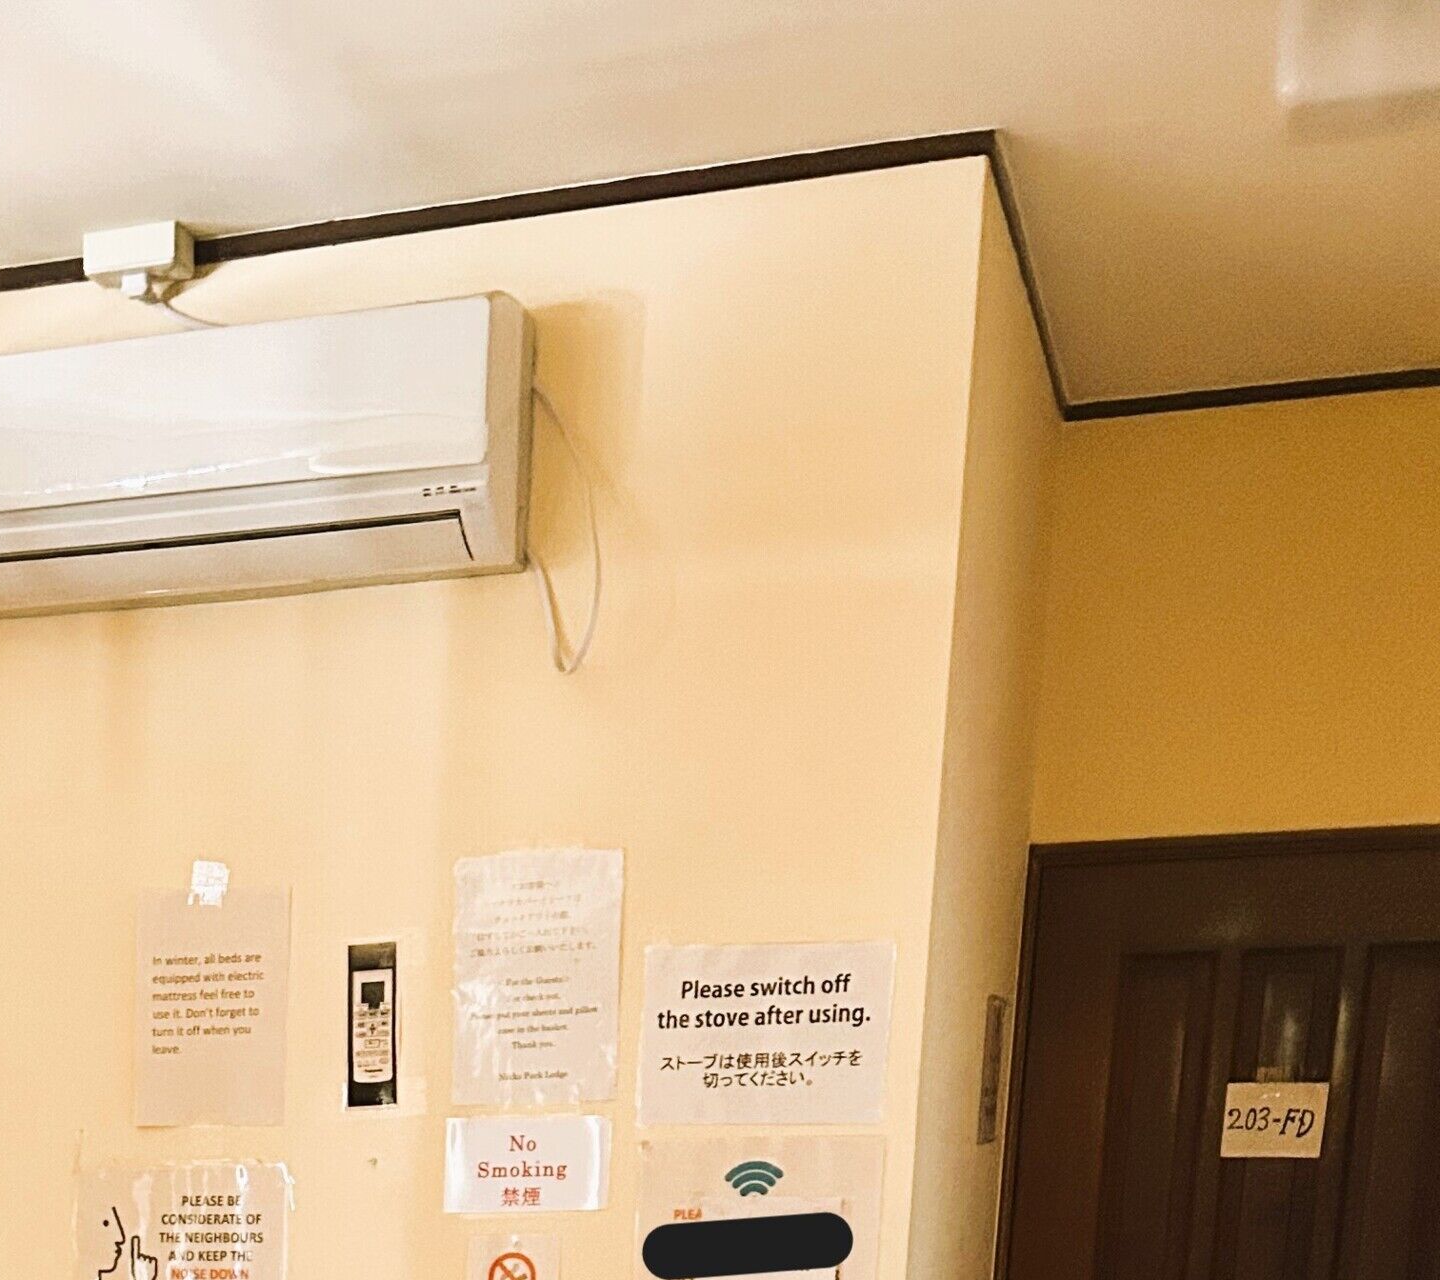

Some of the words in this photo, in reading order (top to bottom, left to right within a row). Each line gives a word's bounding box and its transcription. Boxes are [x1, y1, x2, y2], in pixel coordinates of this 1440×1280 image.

[153, 957, 162, 965] In
[165, 955, 200, 966] winter,
[204, 954, 215, 964] all
[218, 953, 242, 963] beds
[245, 954, 261, 962] are
[152, 973, 201, 985] equipped
[203, 972, 225, 981] with
[228, 971, 264, 981] electric
[681, 980, 745, 999] Please
[750, 976, 815, 997] switch
[821, 973, 851, 993] off
[152, 992, 197, 1001] mattress
[200, 990, 218, 1000] feel
[221, 989, 241, 999] free
[244, 990, 255, 998] to
[153, 1011, 170, 1019] use
[173, 1009, 182, 1018] it.
[186, 1008, 213, 1019] Don't
[216, 1007, 245, 1019] forget
[249, 1007, 259, 1016] to
[658, 1009, 690, 1029] the
[694, 1010, 749, 1028] stove
[754, 1005, 803, 1026] after
[809, 1003, 871, 1027] using.
[152, 1028, 174, 1036] turn
[176, 1027, 184, 1036] it
[186, 1026, 200, 1035] off
[203, 1026, 230, 1035] when
[233, 1027, 251, 1036] you
[152, 1045, 181, 1054] leave.
[660, 1050, 863, 1070] ストーブは使用後スイッチを
[703, 1071, 813, 1088] 切ってください。
[1227, 1107, 1314, 1138] 203-FD
[510, 1135, 537, 1151] No
[478, 1160, 567, 1180] Smoking
[182, 1196, 224, 1206] PLEASE
[227, 1195, 241, 1206] BE
[502, 1187, 541, 1206] 禁煙
[161, 1214, 243, 1225] CONSIDERATE
[246, 1214, 262, 1225] OF
[159, 1232, 181, 1243] THE
[185, 1232, 264, 1243] NEIGHBOURS
[199, 1251, 227, 1261] KEEP
[231, 1251, 253, 1261] THE
[171, 1269, 207, 1280] NOSE
